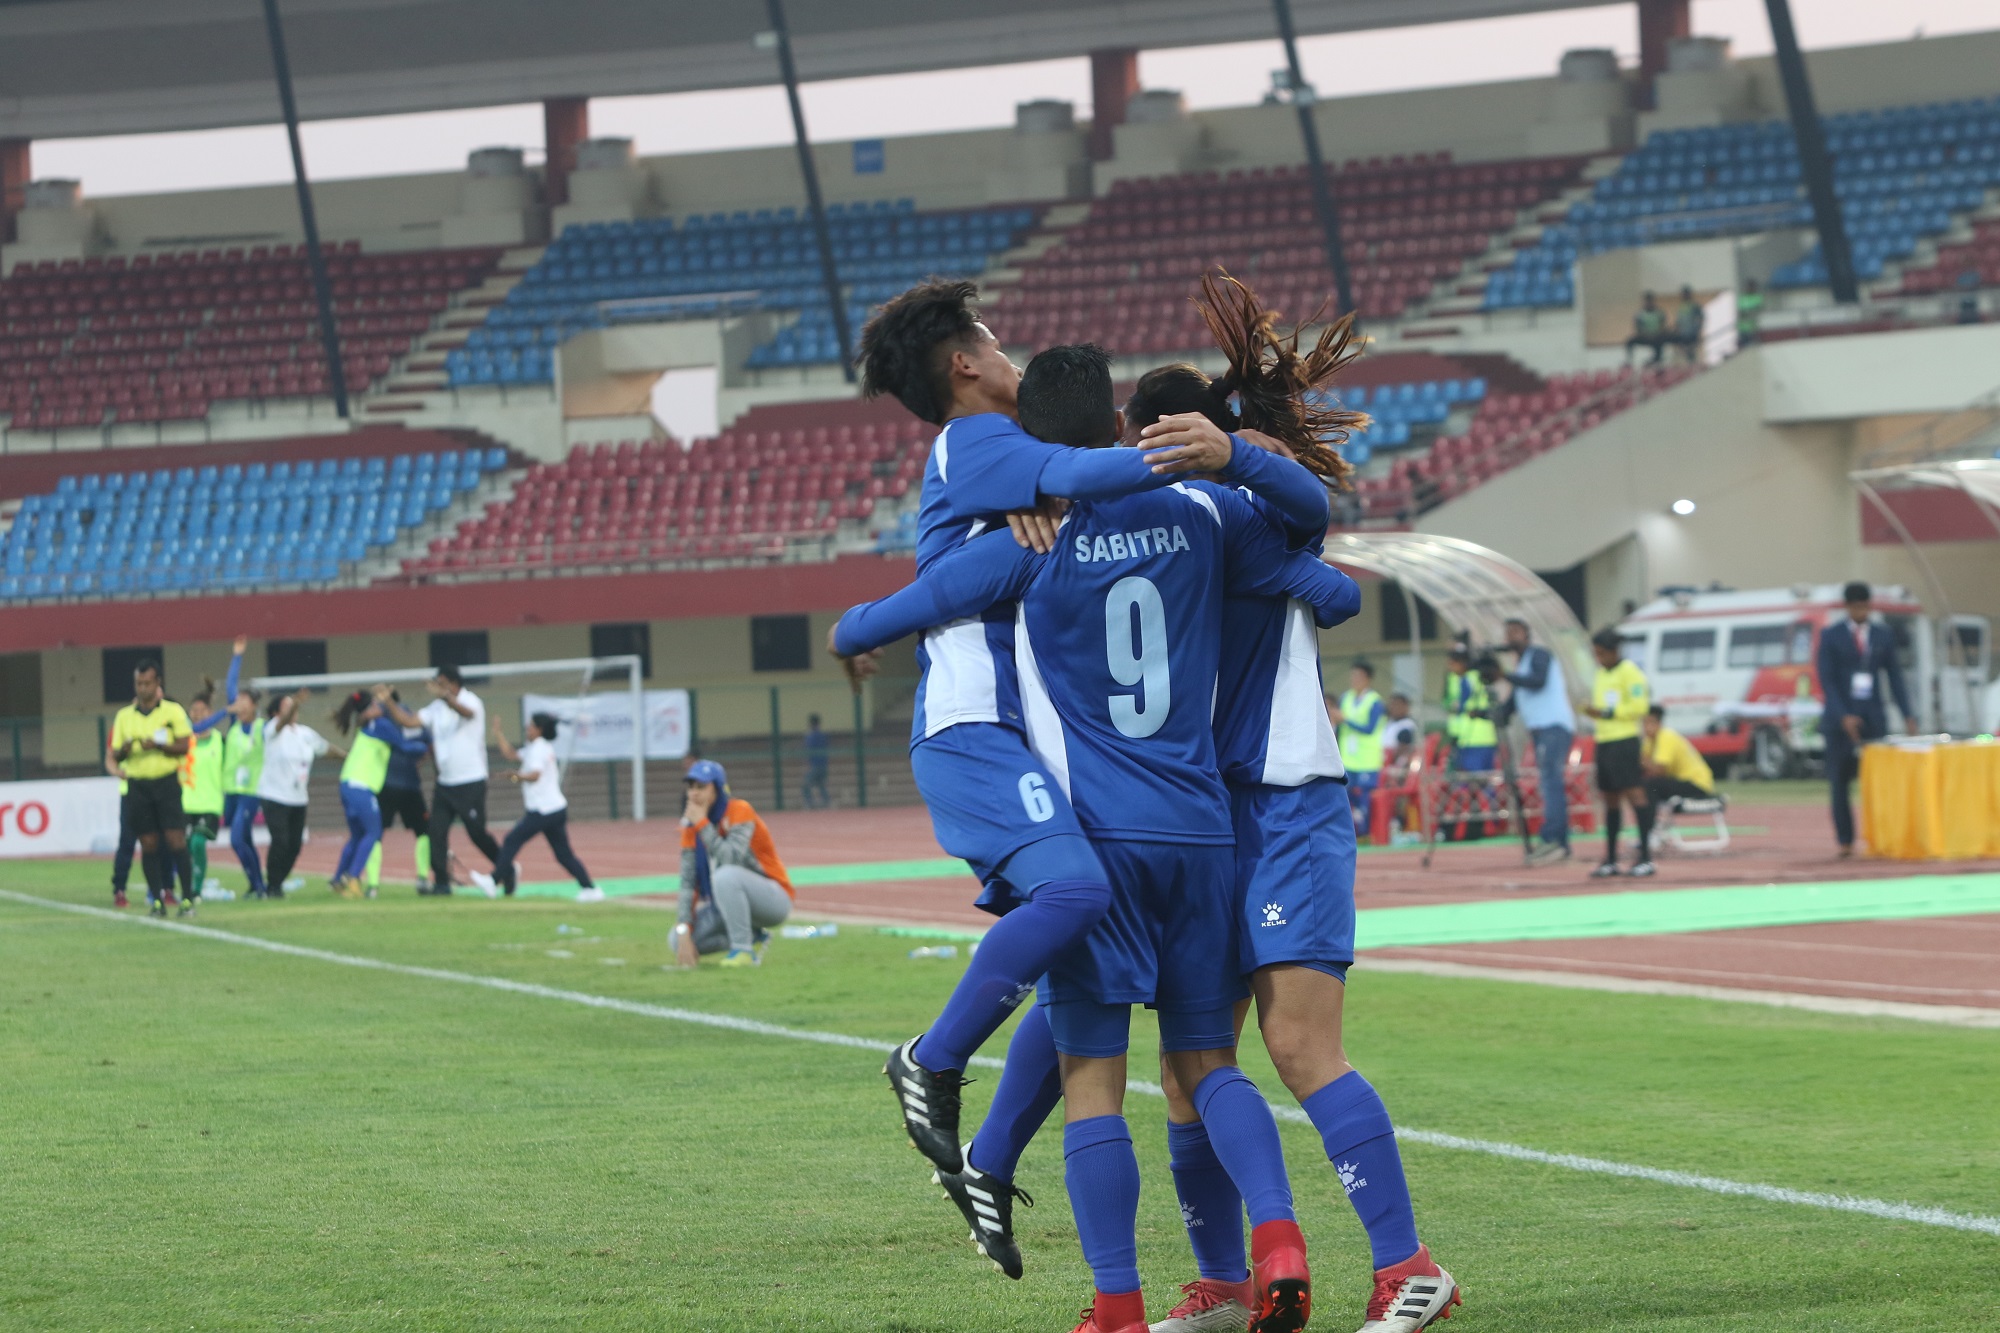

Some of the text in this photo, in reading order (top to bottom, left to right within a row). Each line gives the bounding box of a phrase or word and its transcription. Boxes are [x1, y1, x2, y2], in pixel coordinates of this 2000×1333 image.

[1075, 525, 1190, 562] SABITRA
[1105, 576, 1171, 738] 9
[1018, 771, 1055, 822] 6
[1261, 919, 1287, 927] KELME
